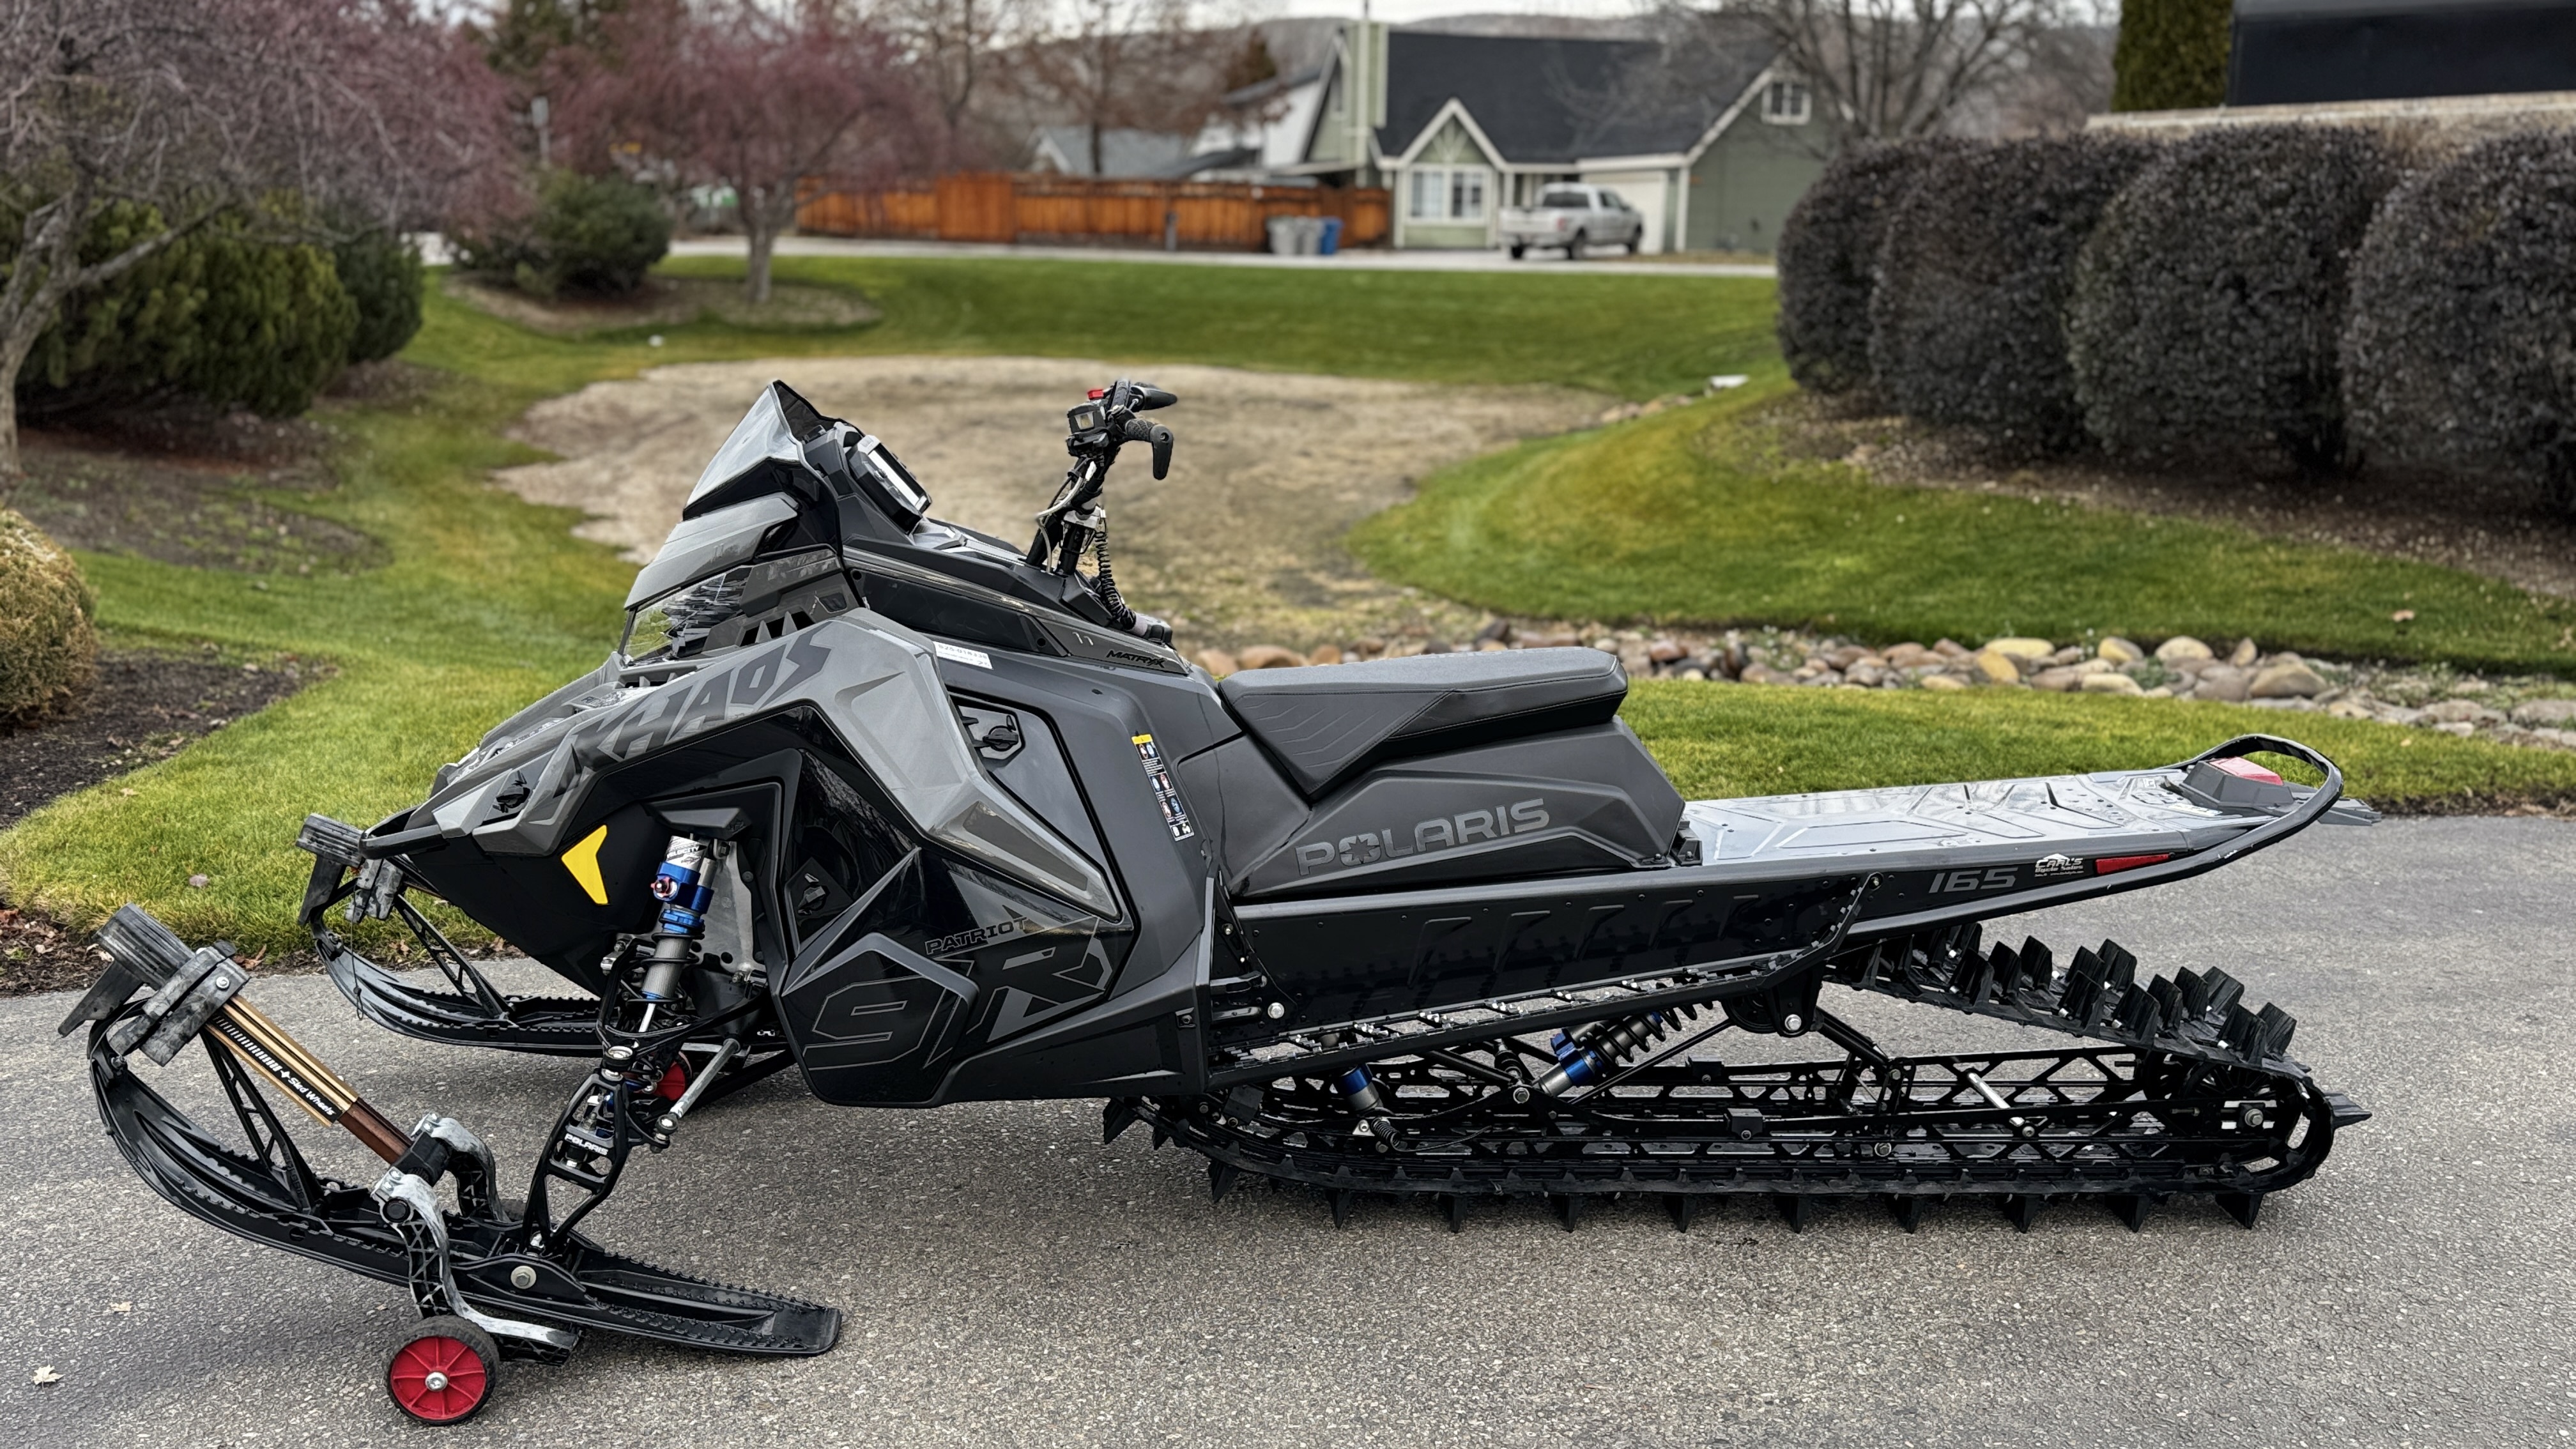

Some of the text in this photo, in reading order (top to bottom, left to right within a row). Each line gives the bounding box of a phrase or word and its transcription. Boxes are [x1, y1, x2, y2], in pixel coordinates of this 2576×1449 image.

[1106, 650, 1167, 669] MATRYX
[562, 620, 832, 783] KHAOS
[1294, 798, 1550, 876] POLARIS
[1928, 867, 2019, 894] 165
[924, 916, 1027, 955] PATRIOT
[288, 1077, 337, 1116] Sled Wheels
[564, 1133, 609, 1156] POLARIS
